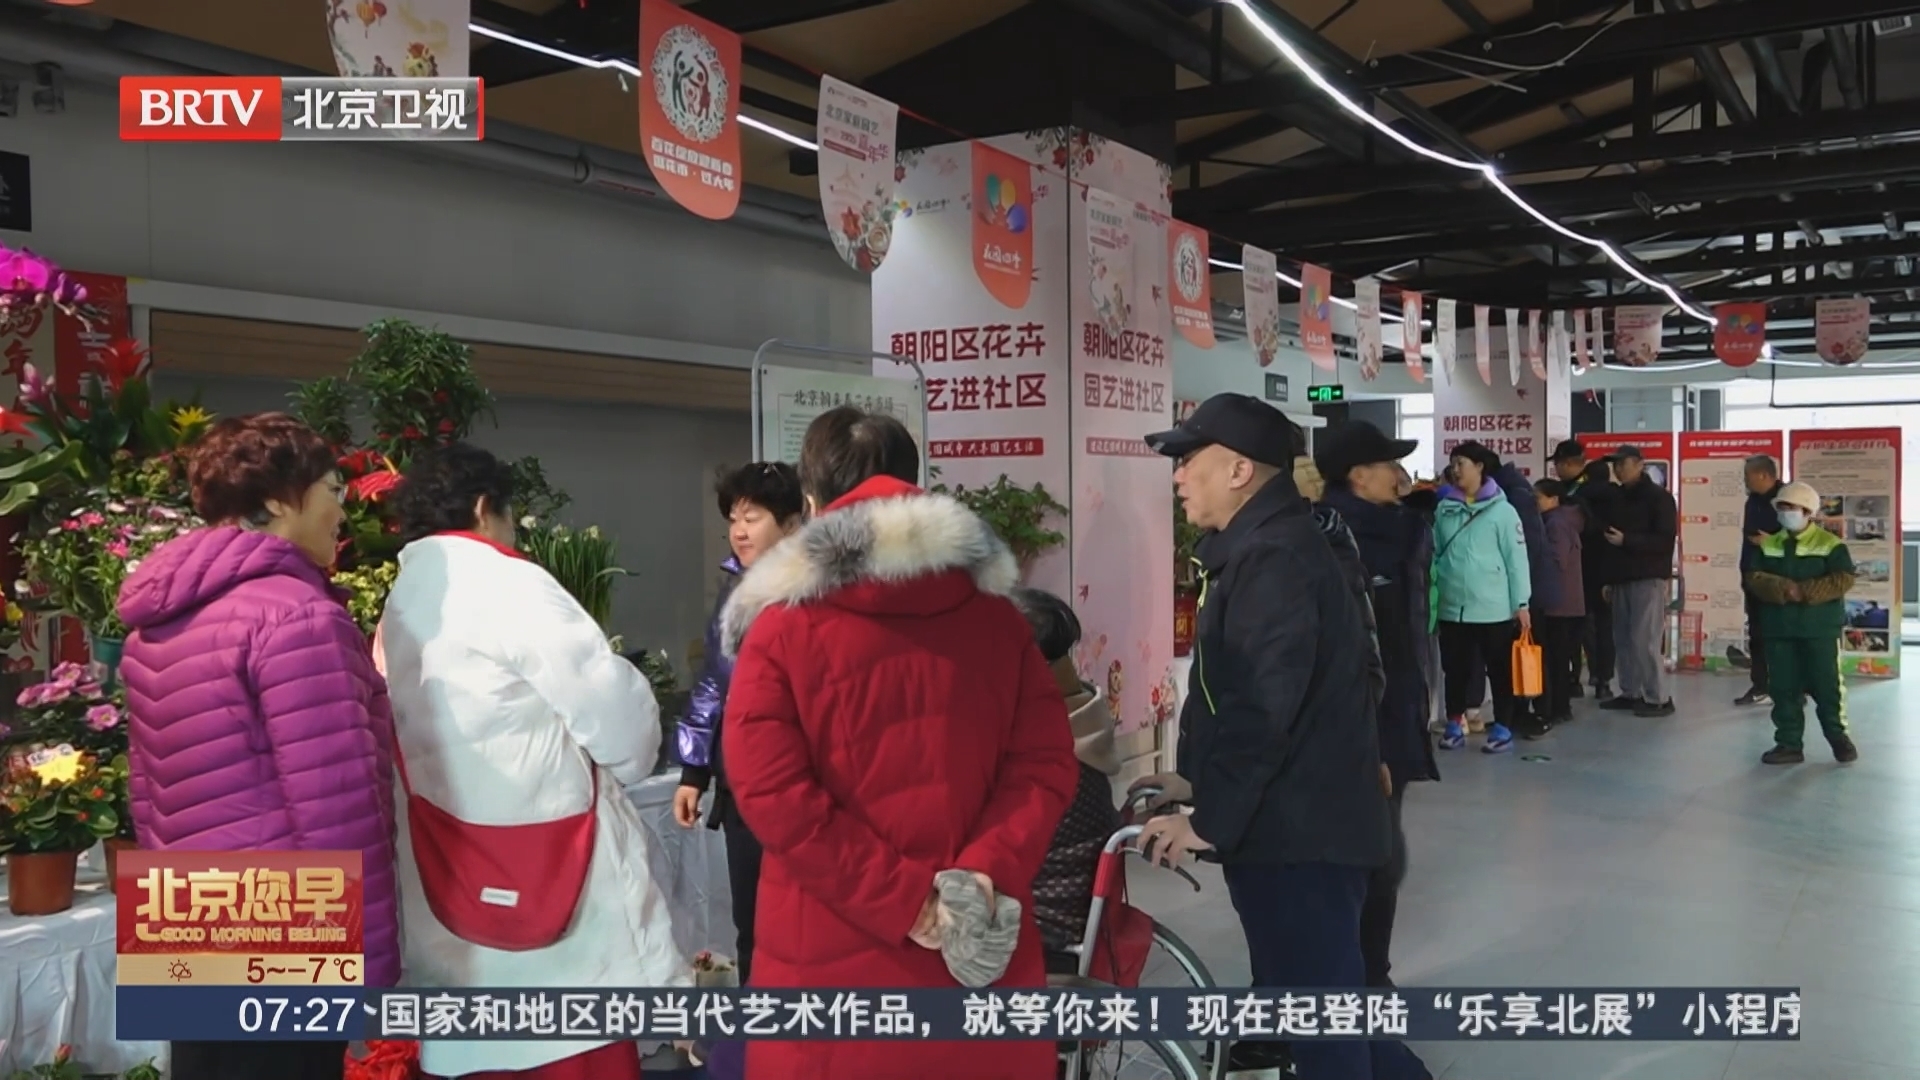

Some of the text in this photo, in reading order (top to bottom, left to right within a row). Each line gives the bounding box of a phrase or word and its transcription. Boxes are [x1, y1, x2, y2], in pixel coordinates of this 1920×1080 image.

[890, 321, 1046, 365] 朝阳区花卉
[1083, 321, 1165, 367] 朝阳区花卉
[925, 373, 1046, 411] 艺进社区
[1084, 372, 1165, 413] 园艺进社区
[1443, 414, 1532, 432] 朝阳区花卉
